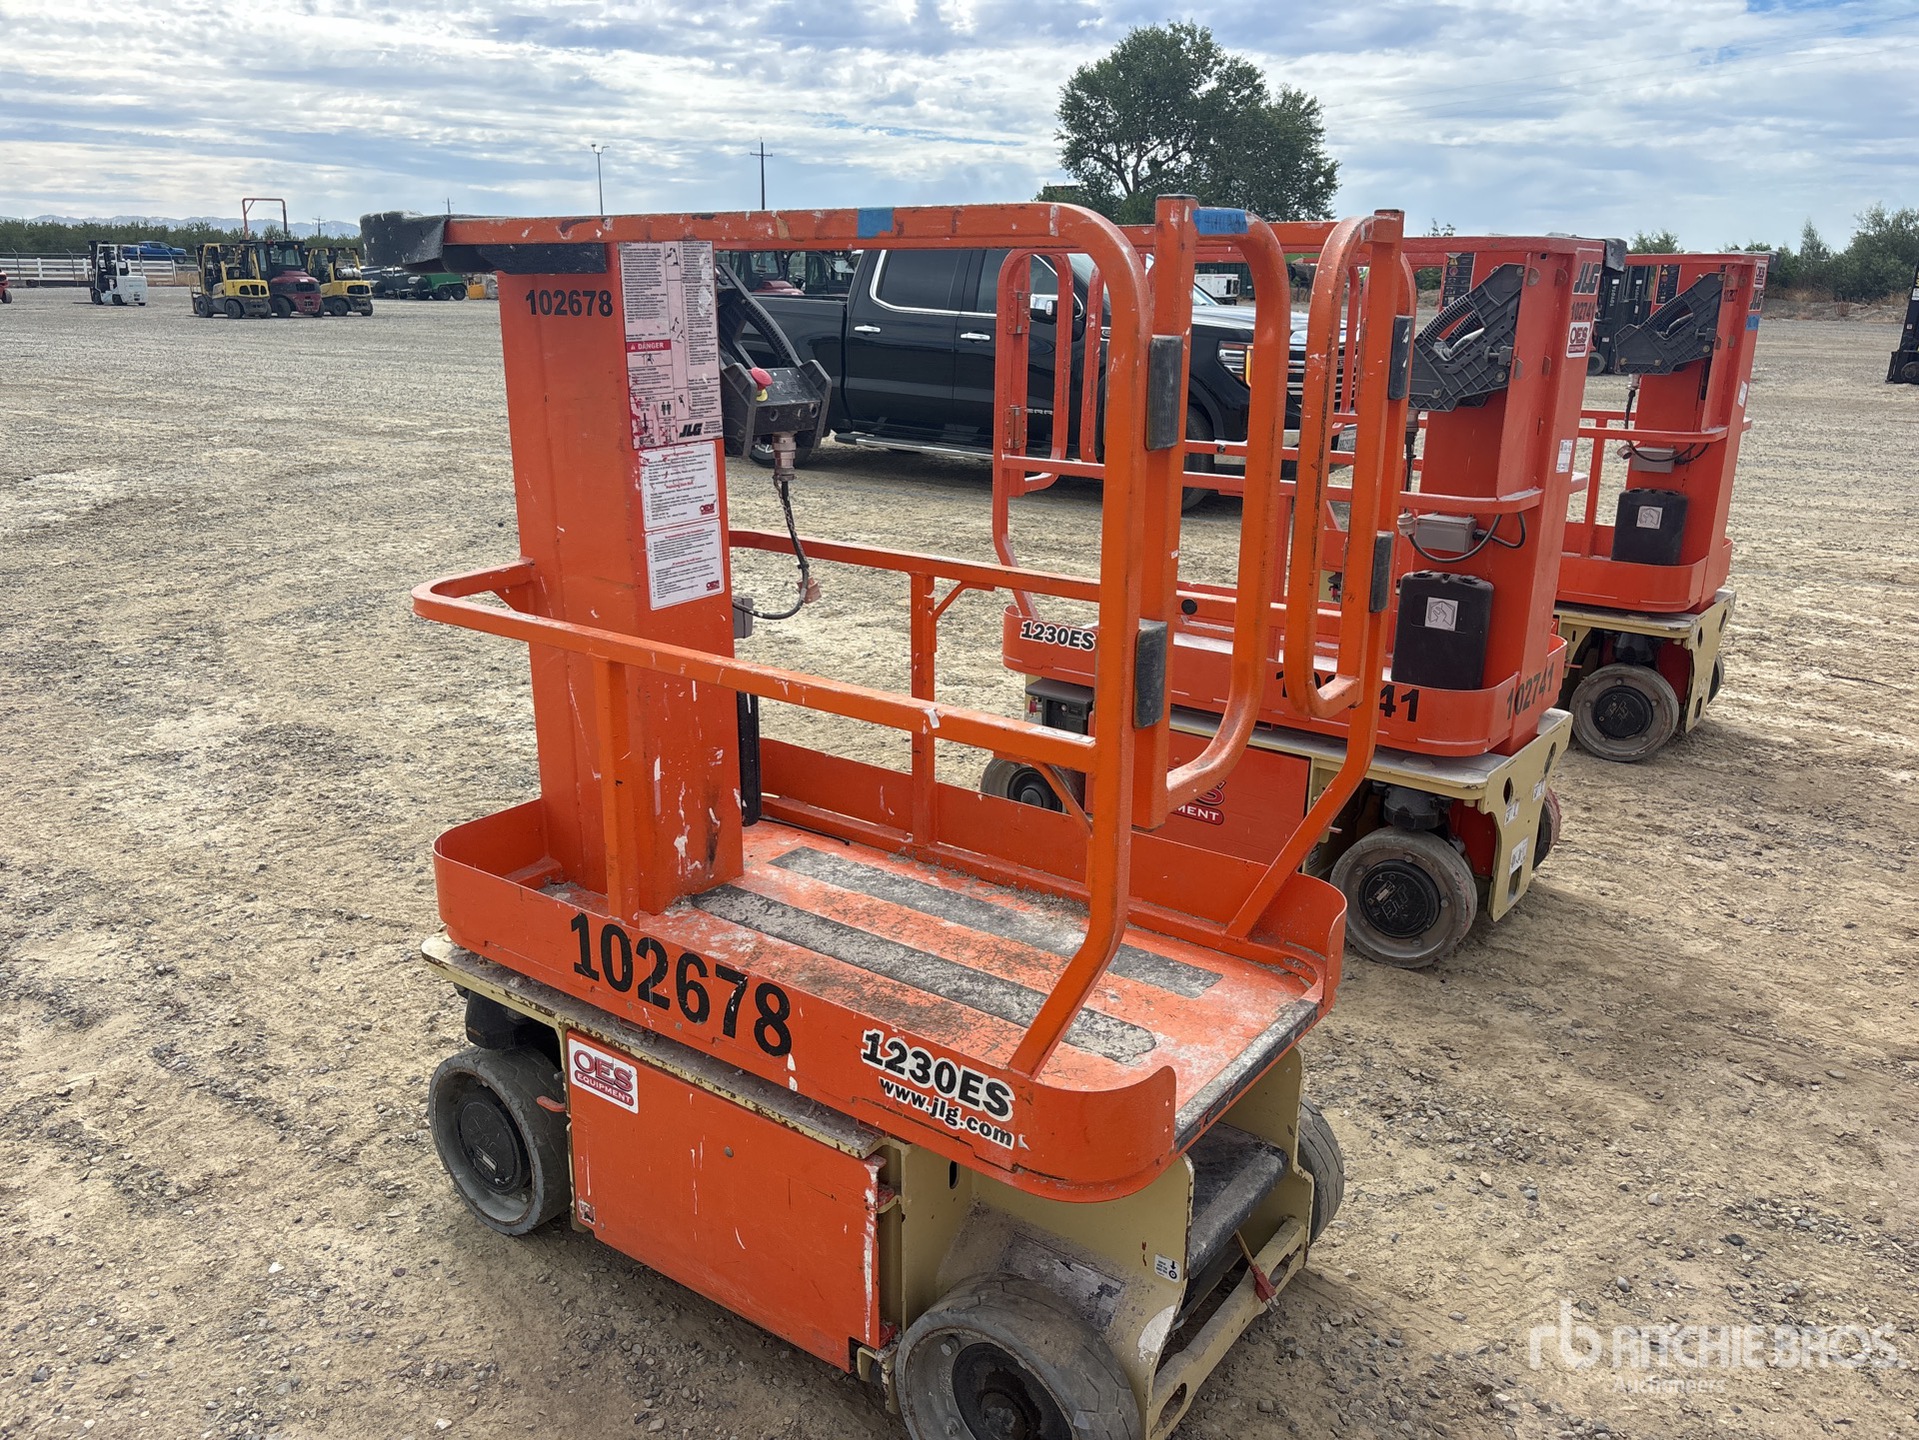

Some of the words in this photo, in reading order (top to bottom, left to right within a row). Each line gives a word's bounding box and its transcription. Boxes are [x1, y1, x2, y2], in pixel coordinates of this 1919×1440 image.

[526, 290, 613, 317] 102678
[1610, 285, 1618, 307] TOYOTA
[637, 342, 665, 350] DANGER
[1570, 327, 1588, 344] OES
[679, 423, 703, 438] JLG
[1021, 622, 1095, 650] 1230ES
[1507, 662, 1554, 720] 102741
[571, 913, 792, 1057] 102678
[574, 1050, 633, 1092] OES
[861, 1030, 1012, 1119] 1230ES
[577, 1073, 632, 1103] EQUIPMENT
[879, 1077, 1013, 1147] www.jlg.com
